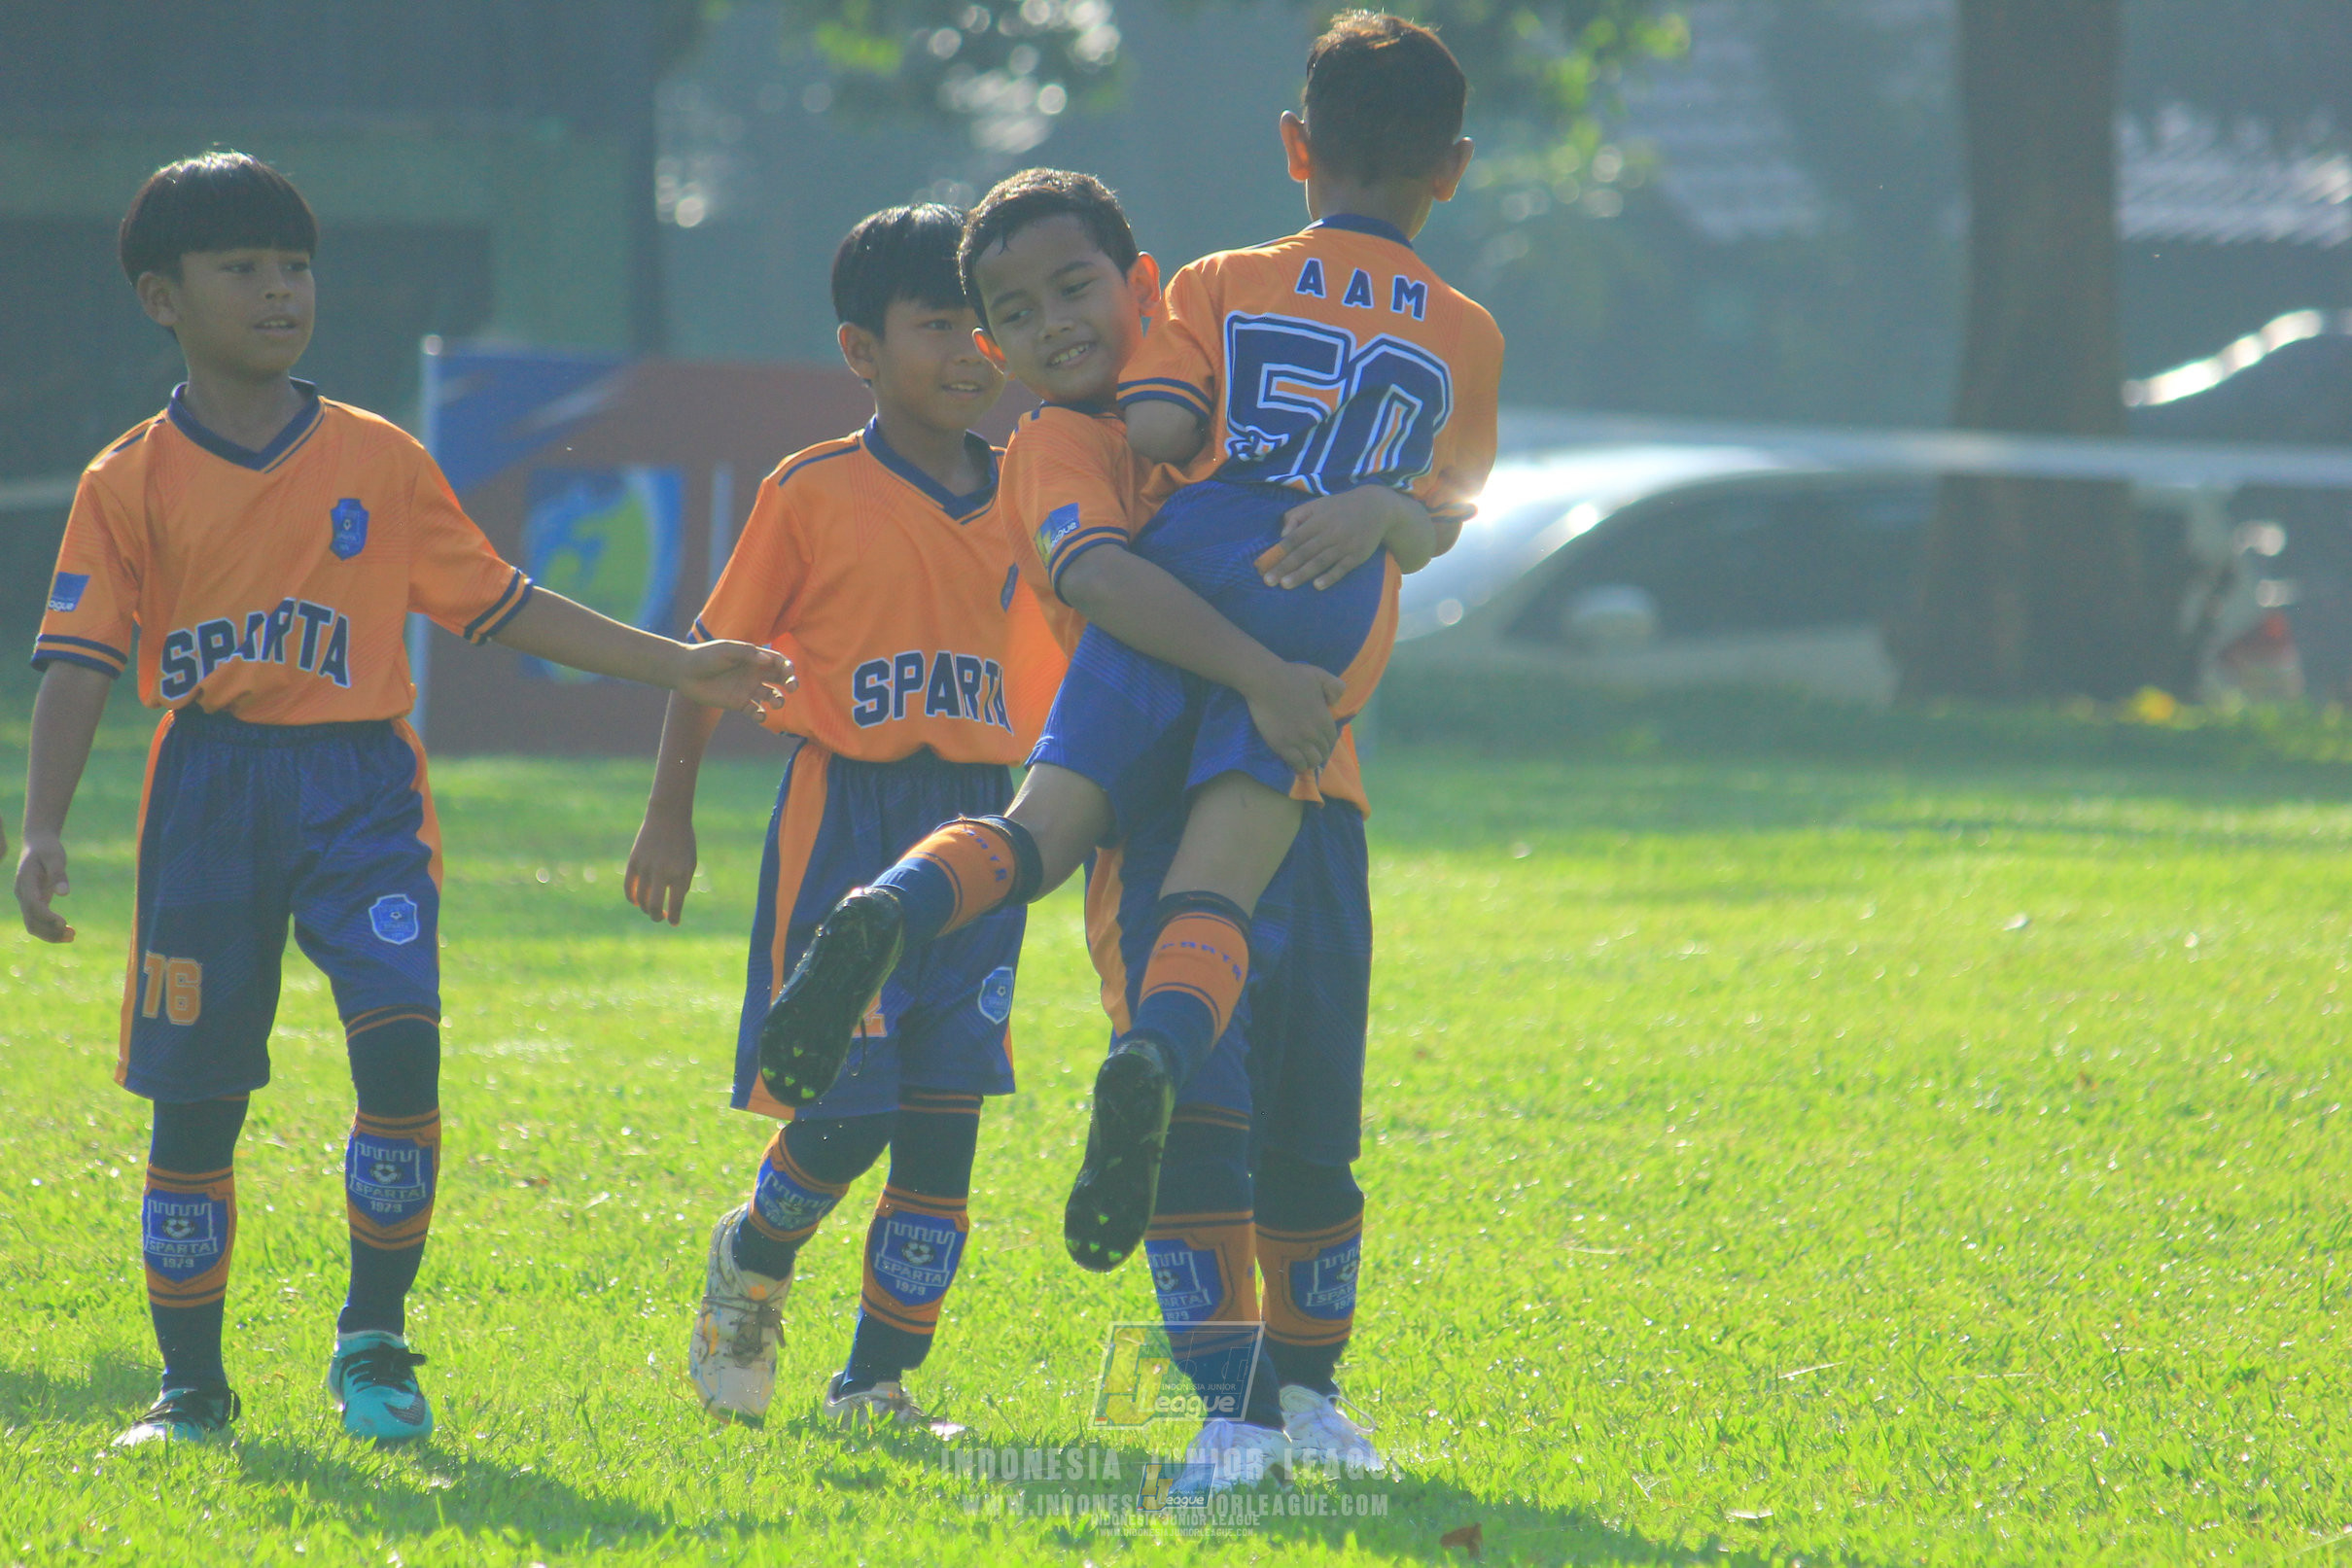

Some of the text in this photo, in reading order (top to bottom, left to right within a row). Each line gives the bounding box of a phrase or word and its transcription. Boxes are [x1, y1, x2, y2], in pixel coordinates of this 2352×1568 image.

[1294, 257, 1428, 322] AAM
[1224, 309, 1454, 496] 50
[160, 596, 351, 701] SPARTA
[355, 1183, 421, 1199] SPARTA
[369, 1200, 403, 1214] 1979
[148, 1240, 211, 1255] SPARTA
[161, 1256, 195, 1269] 1979
[881, 1259, 943, 1284] SPARTA
[895, 1279, 927, 1296] 1979
